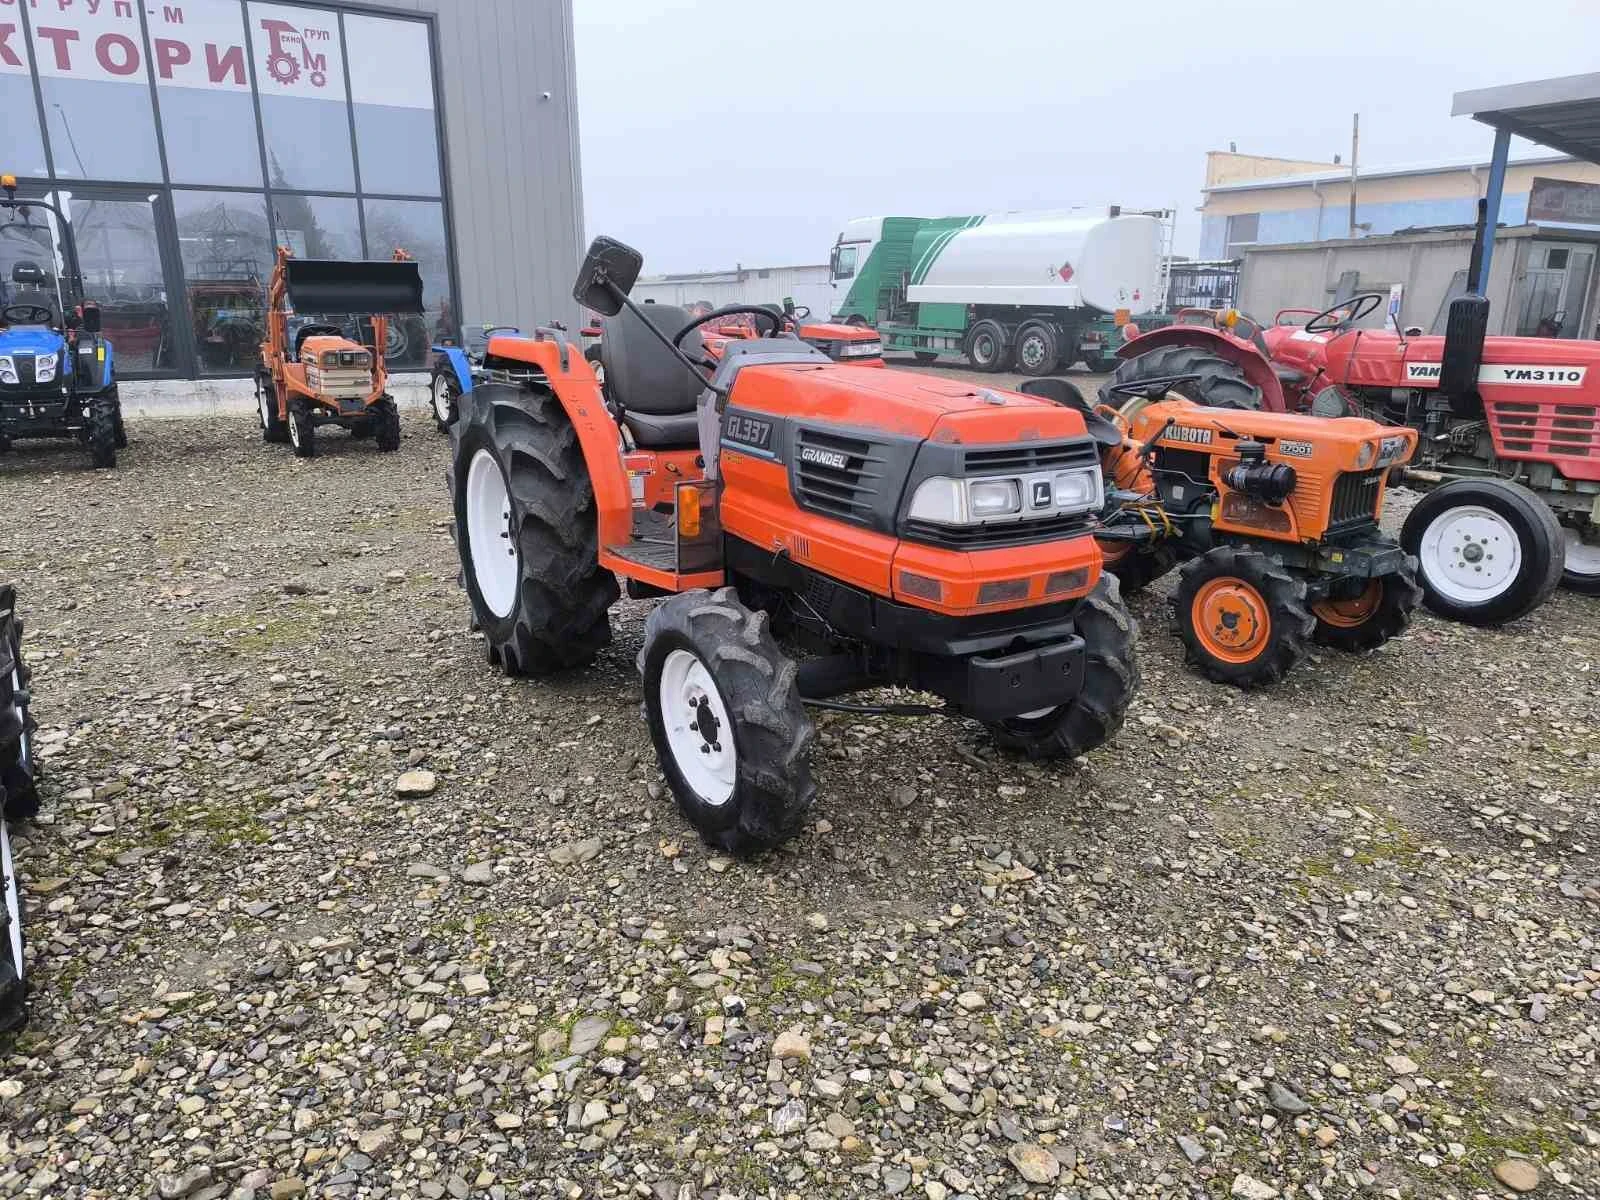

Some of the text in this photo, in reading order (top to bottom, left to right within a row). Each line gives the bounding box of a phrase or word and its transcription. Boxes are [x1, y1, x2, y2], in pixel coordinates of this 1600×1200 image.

[304, 28, 330, 41] ГРУП
[1503, 369, 1581, 382] YM3110
[726, 416, 769, 445] GL337
[1165, 425, 1212, 444] KUBOTA
[801, 448, 846, 469] GRANDEL
